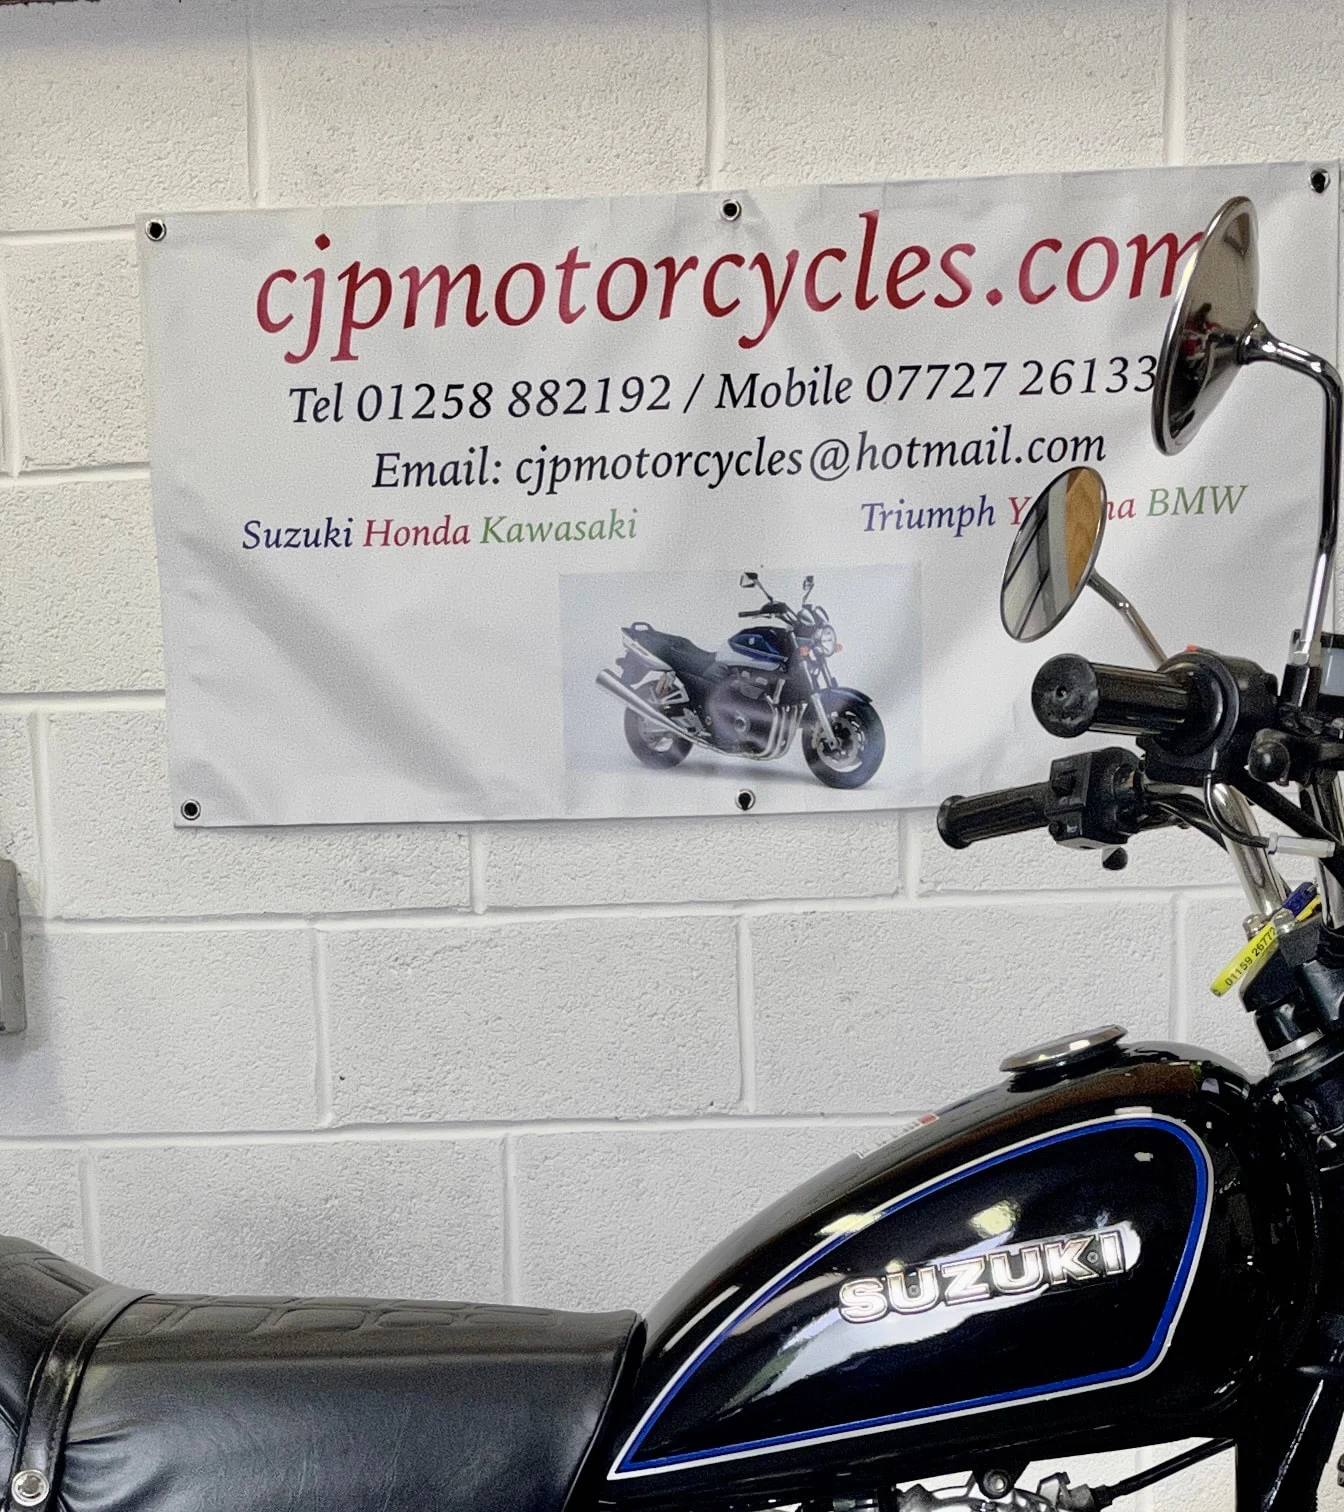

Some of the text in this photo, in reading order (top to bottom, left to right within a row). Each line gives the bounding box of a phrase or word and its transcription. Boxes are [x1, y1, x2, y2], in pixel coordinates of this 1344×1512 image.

[256, 207, 1205, 364] cjpmotorcycles.com
[288, 354, 1158, 424] Tel 01258 882192 / Mobile 07727 26133
[371, 424, 1107, 496] Email: cjpmotorcycles@hotmail.com
[241, 508, 638, 550] Suzuki Honda Kawasaki
[861, 493, 996, 538] Triumph
[1147, 484, 1250, 518] BMW
[1224, 956, 1254, 987] 01159
[838, 1230, 1128, 1325] SUZUKI
